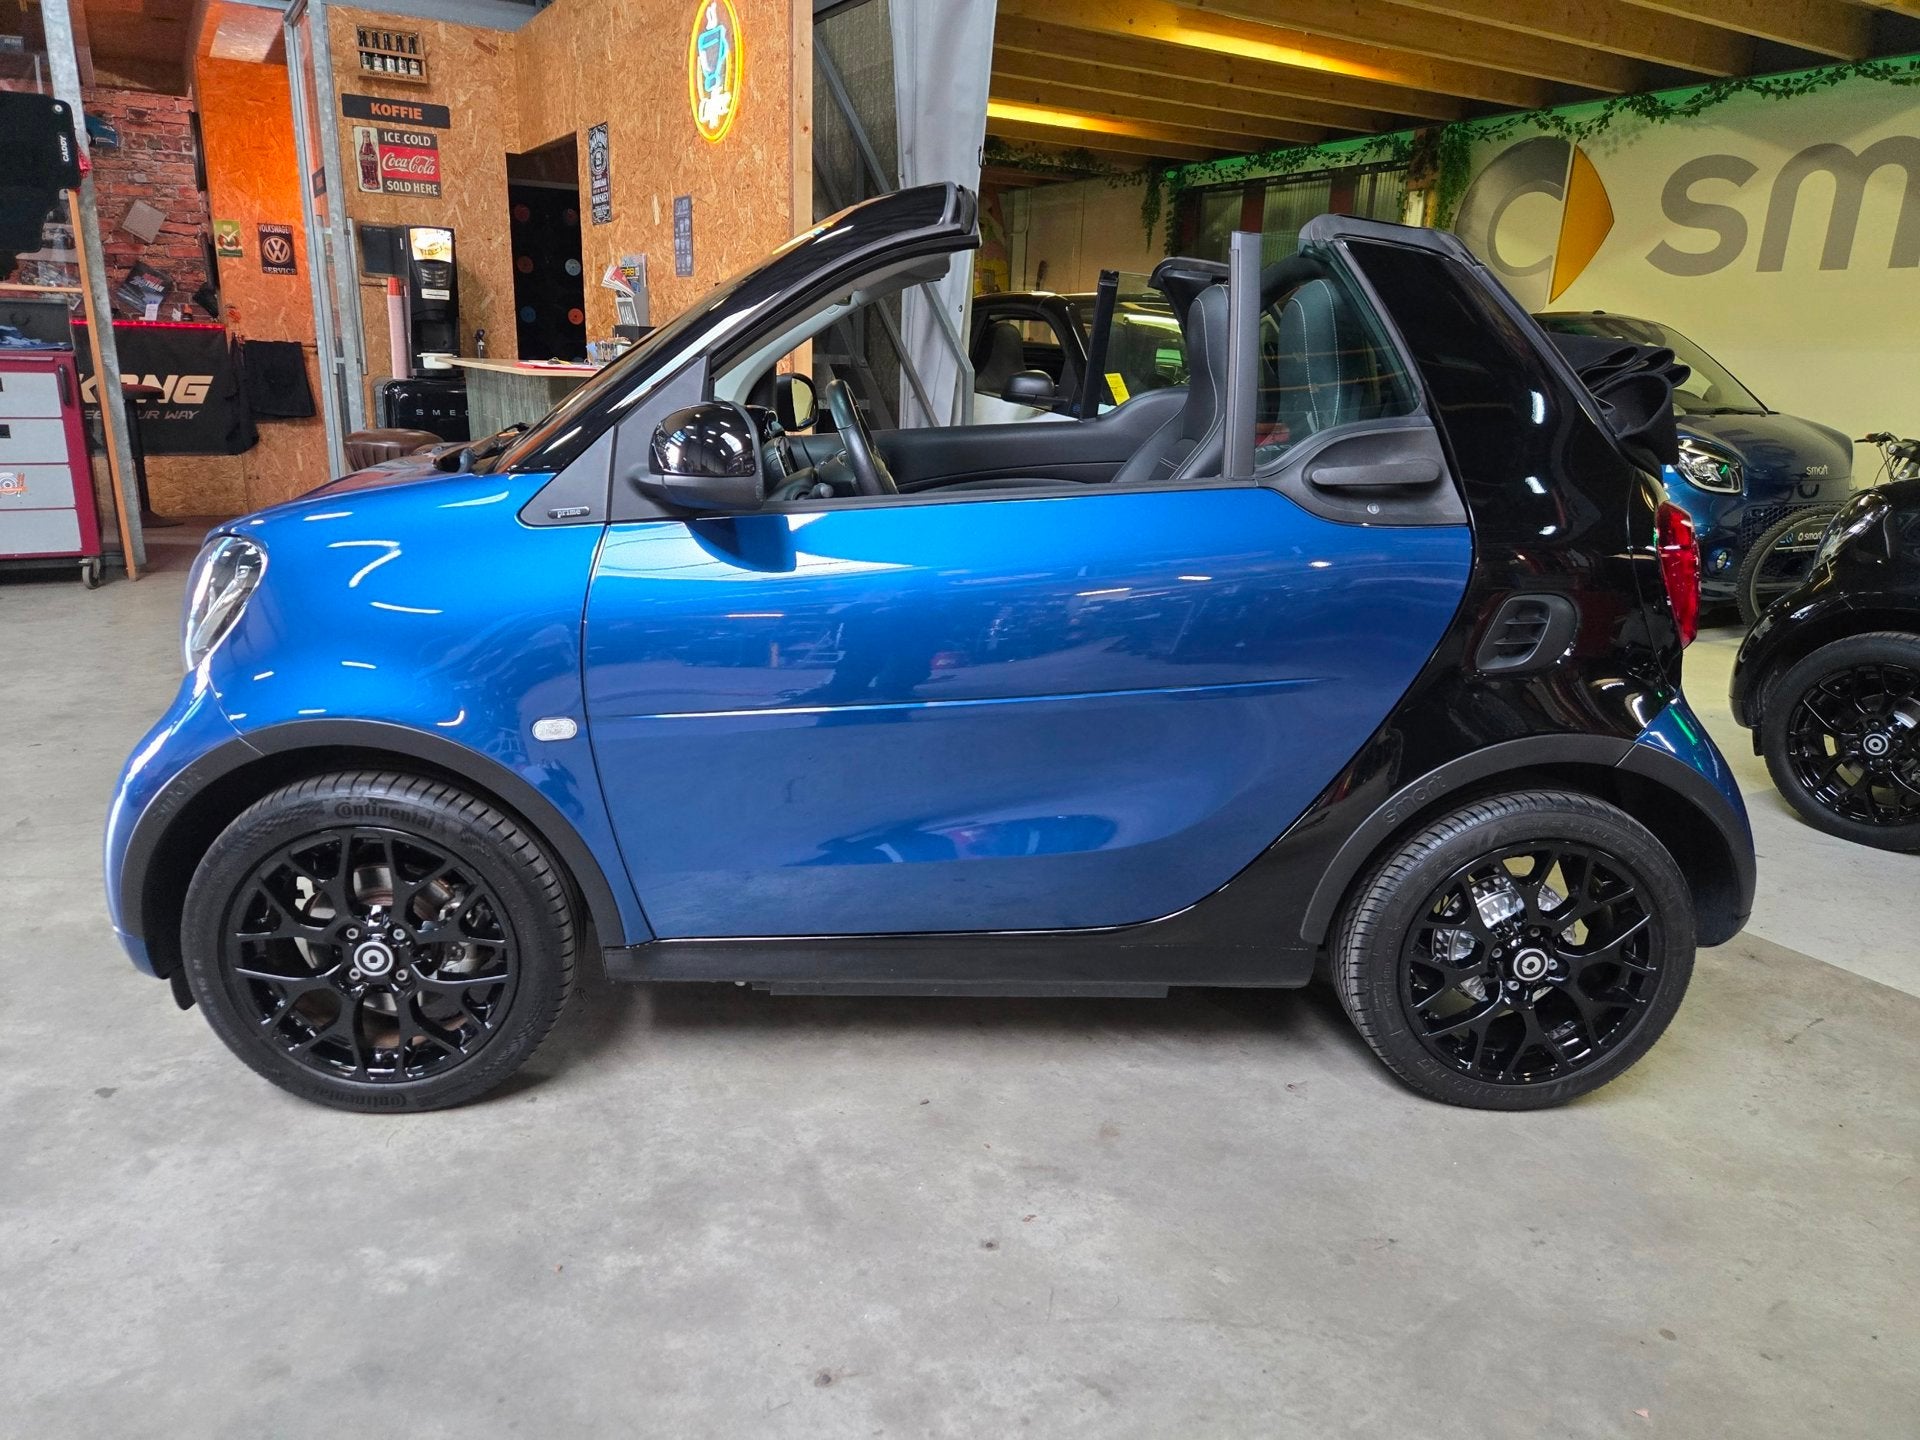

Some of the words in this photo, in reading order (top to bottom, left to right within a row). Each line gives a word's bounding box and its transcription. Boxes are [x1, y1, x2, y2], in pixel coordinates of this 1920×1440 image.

[370, 102, 423, 120] KOFFIE
[384, 131, 400, 143] ICE
[403, 134, 431, 146] COLD
[59, 135, 70, 162] CADDY
[381, 152, 436, 175] Coca-Cola
[386, 180, 411, 192] SOLD
[413, 182, 438, 195] HERE
[262, 266, 296, 274] SERVICE
[164, 410, 200, 420] WAY
[1806, 464, 1829, 476] smart
[557, 509, 581, 518] prime
[1382, 773, 1447, 825] smart
[334, 801, 437, 829] Continental
